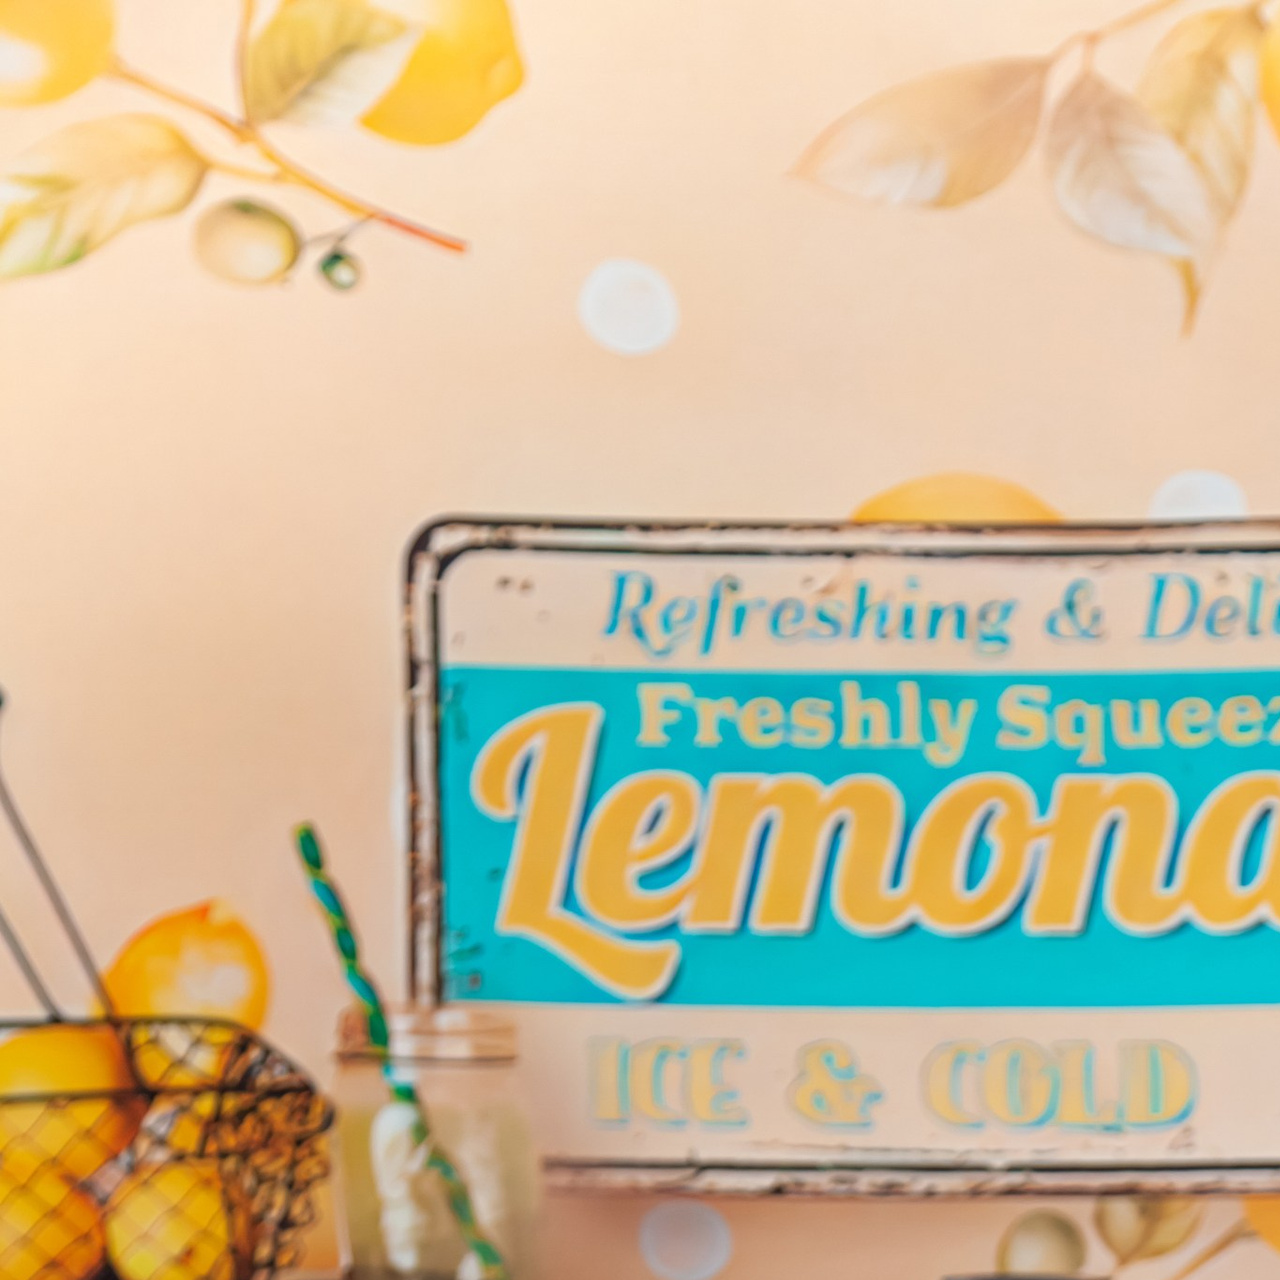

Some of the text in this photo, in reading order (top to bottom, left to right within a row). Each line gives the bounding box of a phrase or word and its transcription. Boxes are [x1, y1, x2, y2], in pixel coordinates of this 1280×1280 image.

[602, 569, 1022, 659] Refreshing
[1043, 576, 1106, 641] &
[635, 680, 978, 768] Freshly
[586, 1036, 1198, 1135] ICE & COLD
